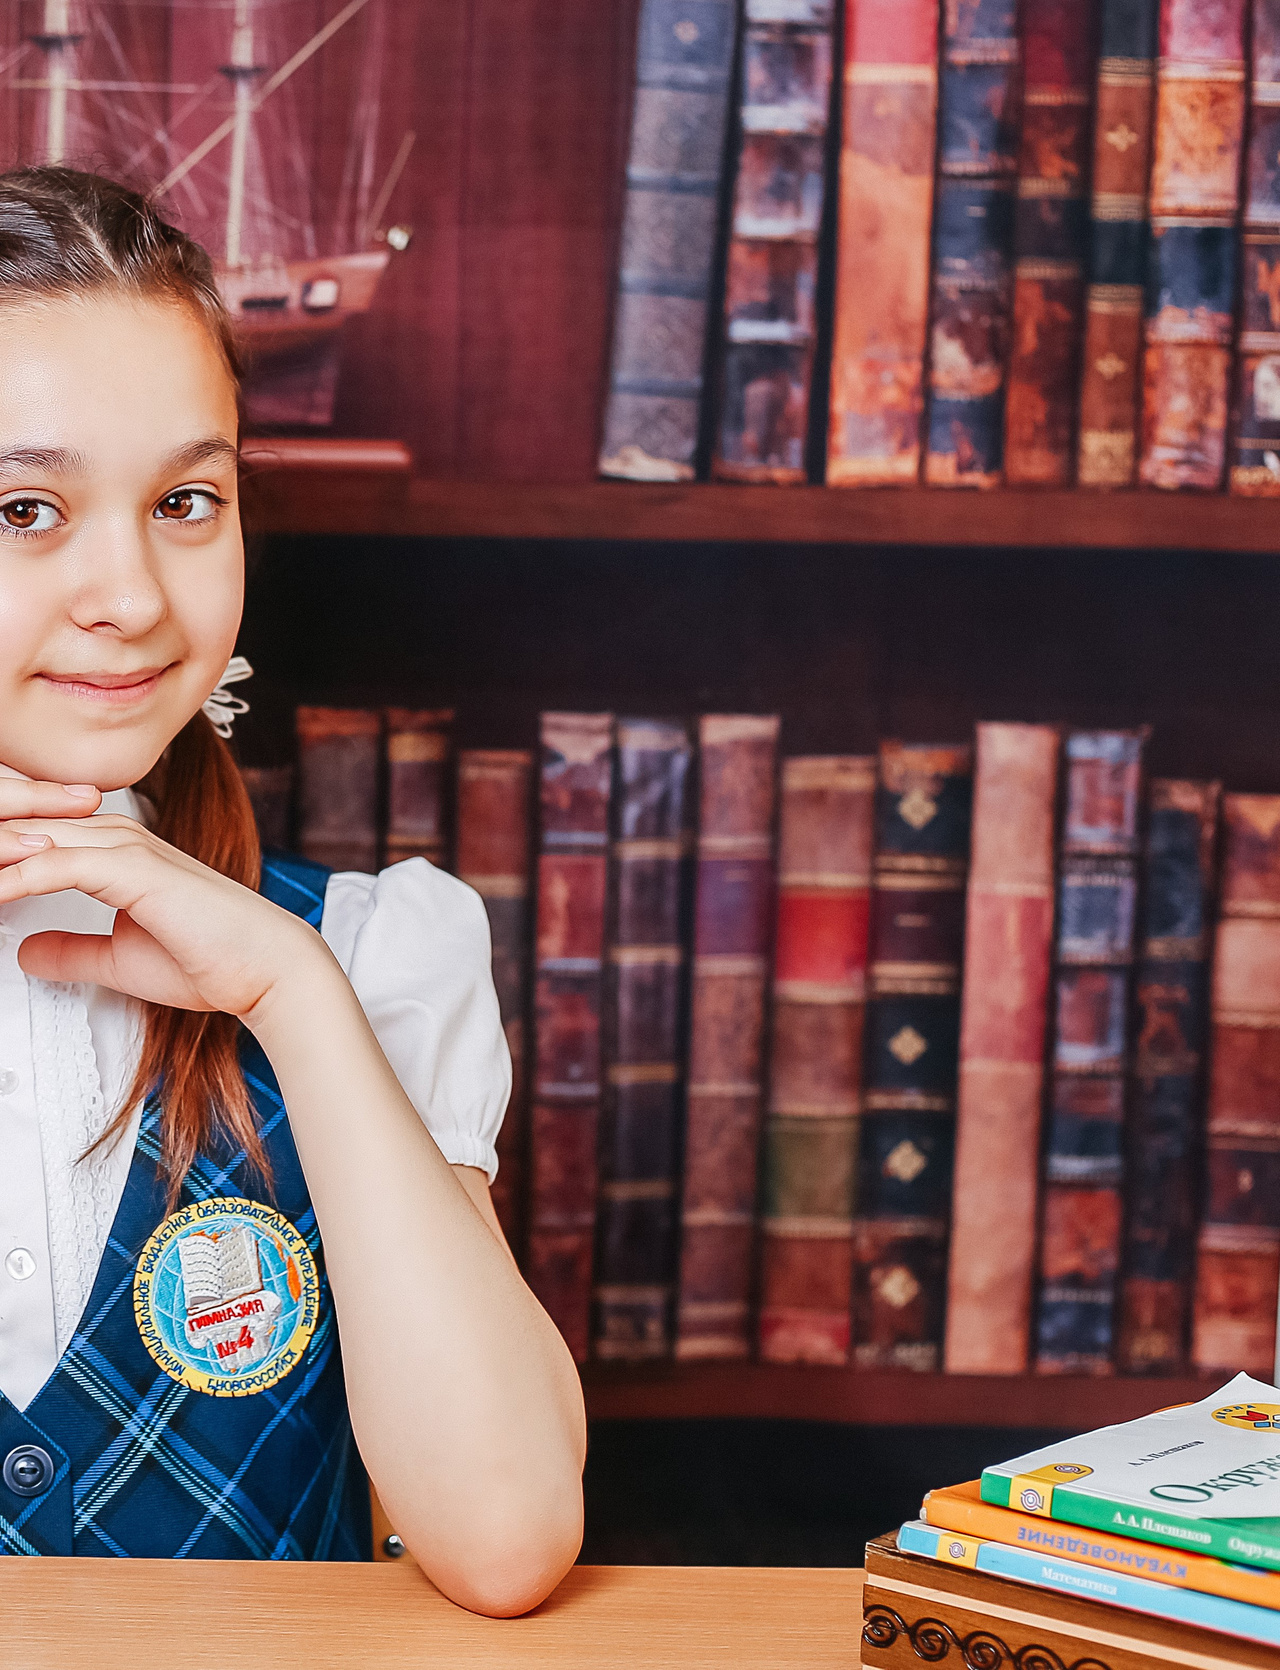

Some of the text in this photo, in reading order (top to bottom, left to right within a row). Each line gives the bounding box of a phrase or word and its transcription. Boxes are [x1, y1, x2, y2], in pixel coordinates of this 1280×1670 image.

[142, 1210, 195, 1273] БЮДЖЕТНОЕ
[197, 1202, 299, 1247] ОБРАЗОВАТЕЛЬНОЕ
[188, 1298, 265, 1332] ГИМНАЗИЯ
[1017, 1526, 1188, 1578] КУБАНОВЕДЕНИЕ
[1041, 1566, 1118, 1596] Математика
